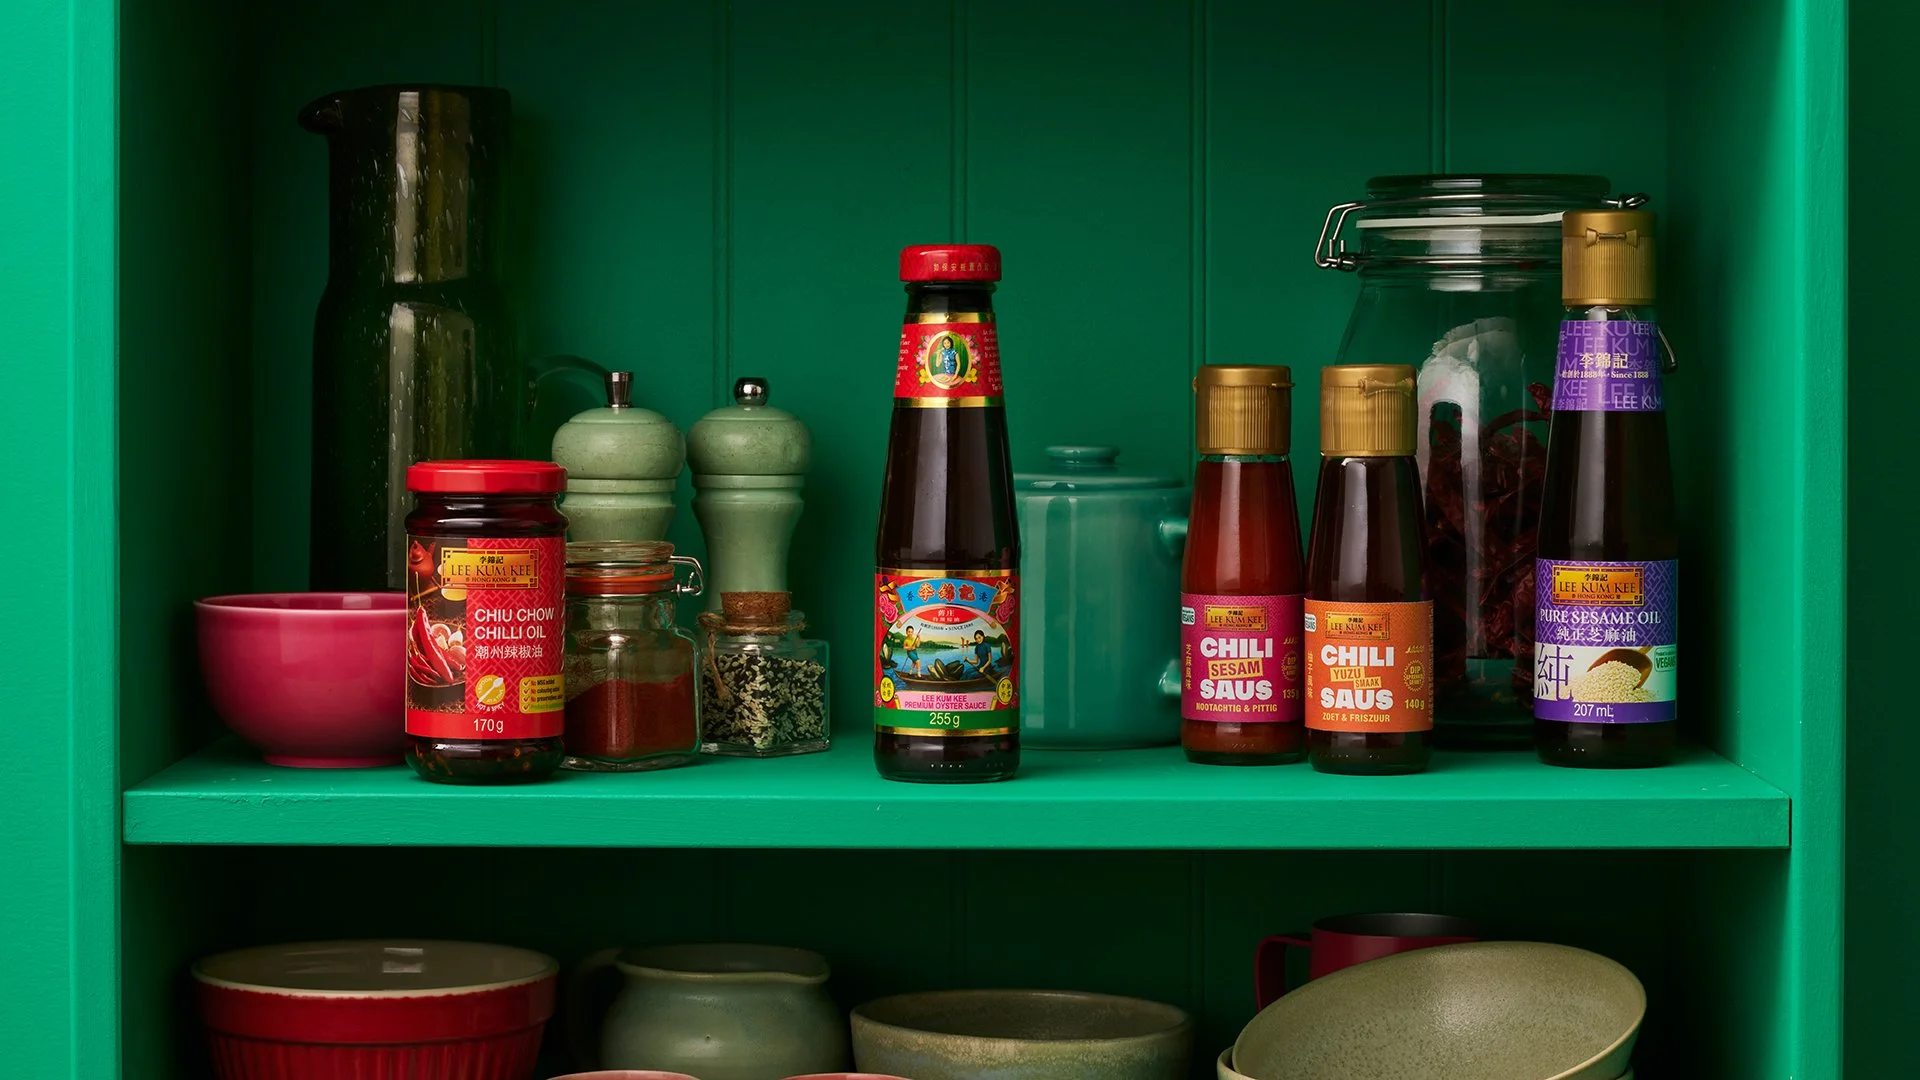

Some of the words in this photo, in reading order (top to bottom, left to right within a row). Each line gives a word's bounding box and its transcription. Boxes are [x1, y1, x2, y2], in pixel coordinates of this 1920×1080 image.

[1580, 352, 1629, 369] 李錦記
[1611, 370, 1632, 379] Since
[1634, 370, 1649, 379] 1888
[479, 556, 504, 564] 李錦記
[451, 565, 471, 576] LEE
[476, 565, 507, 576] KUM
[510, 564, 531, 576] KEE
[918, 582, 976, 602] 李錦記
[1559, 582, 1577, 592] LEE
[1581, 582, 1610, 593] KUM
[1614, 582, 1636, 593] KEE
[474, 608, 513, 622] CHIU
[516, 607, 554, 621] CHOW
[1226, 616, 1245, 624] KUM
[1248, 616, 1262, 624] KEE
[1540, 609, 1569, 623] PURE
[1571, 611, 1635, 624] SESAME
[1637, 612, 1661, 624] OIL
[474, 626, 522, 640] CHILLI
[526, 625, 546, 639] OIL
[1346, 623, 1365, 631] KUM
[1368, 623, 1383, 631] KEE
[1556, 627, 1637, 642] 純正芝麻油
[474, 645, 543, 659] 潮州辣椒油
[1200, 637, 1273, 658] CHILI
[1321, 644, 1395, 667] CHILI
[1211, 660, 1260, 677] SESAM
[1333, 668, 1361, 680] YUZU
[1410, 666, 1421, 674] DIP
[1537, 644, 1574, 701] 純
[1200, 679, 1273, 700] SAUS
[1355, 679, 1380, 688] SMAAK
[904, 701, 935, 709] PREMIUM
[1320, 687, 1394, 710] SAUS
[1196, 702, 1241, 712] NOOTACHTIG
[1252, 704, 1278, 712] PITTIG
[1574, 703, 1594, 716] 207
[1322, 712, 1339, 721] ZOET
[1342, 713, 1347, 721] &
[1349, 714, 1390, 722] FRISZUUR
